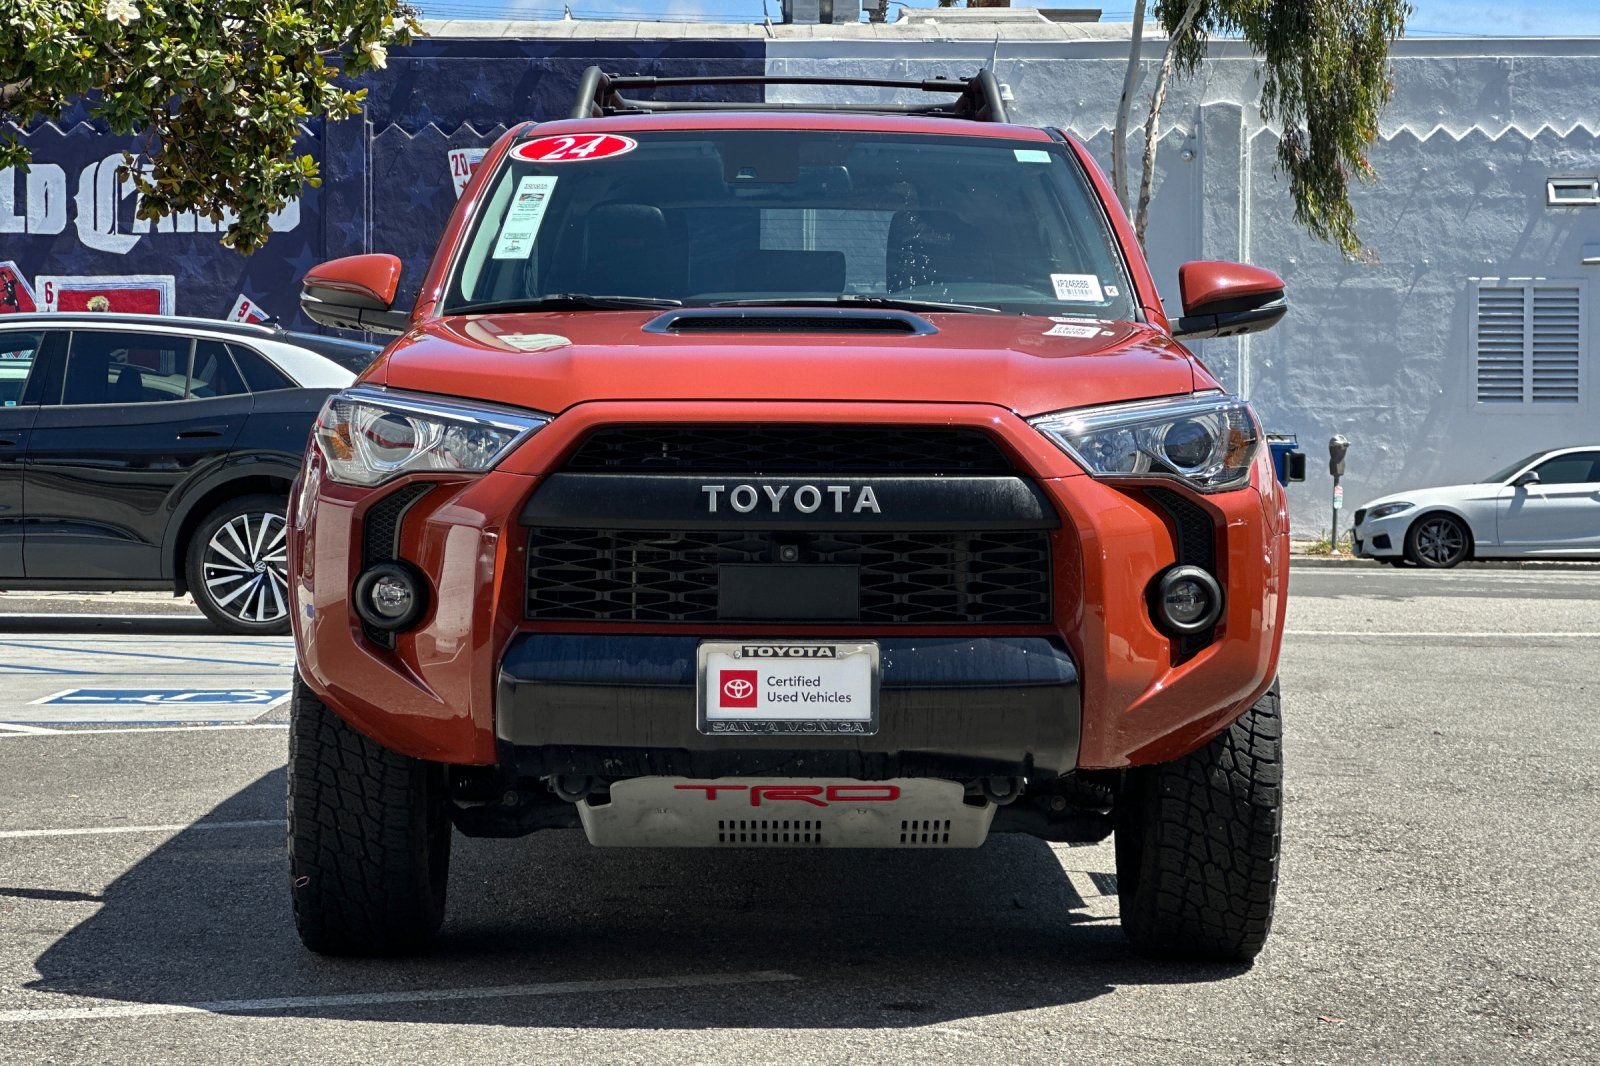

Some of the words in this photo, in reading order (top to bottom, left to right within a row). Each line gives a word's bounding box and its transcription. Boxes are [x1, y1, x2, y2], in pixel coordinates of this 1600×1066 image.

[541, 137, 606, 160] 24
[451, 153, 469, 176] 20
[44, 281, 54, 304] 6
[238, 301, 250, 318] 9
[702, 484, 882, 513] TOYOTA
[745, 646, 833, 657] TOYOTA
[767, 676, 821, 687] Certified
[767, 692, 798, 703] Used
[801, 692, 852, 703] Vehicles
[674, 785, 900, 807] TRD
